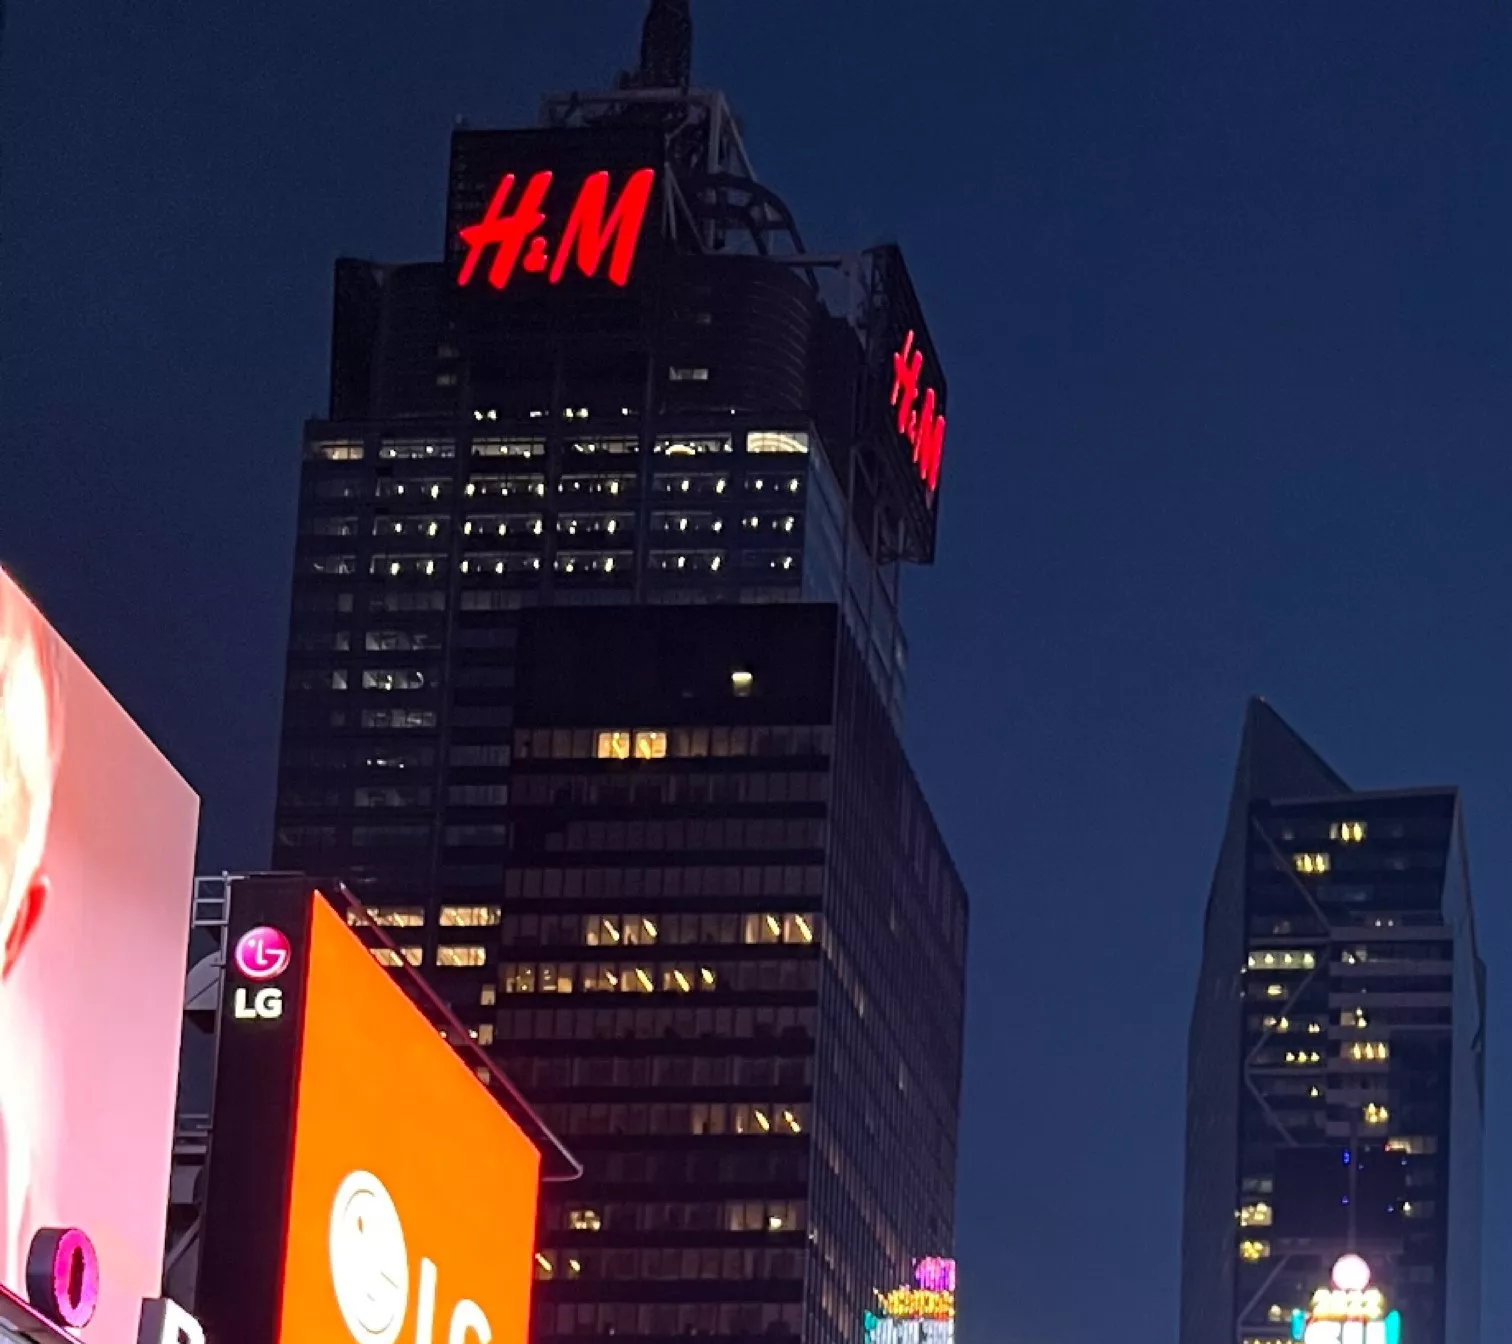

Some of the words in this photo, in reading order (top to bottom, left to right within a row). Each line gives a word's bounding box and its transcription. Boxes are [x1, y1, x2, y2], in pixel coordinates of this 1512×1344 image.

[457, 168, 655, 289] H&M
[891, 330, 945, 491] H&M
[235, 987, 283, 1019] LG
